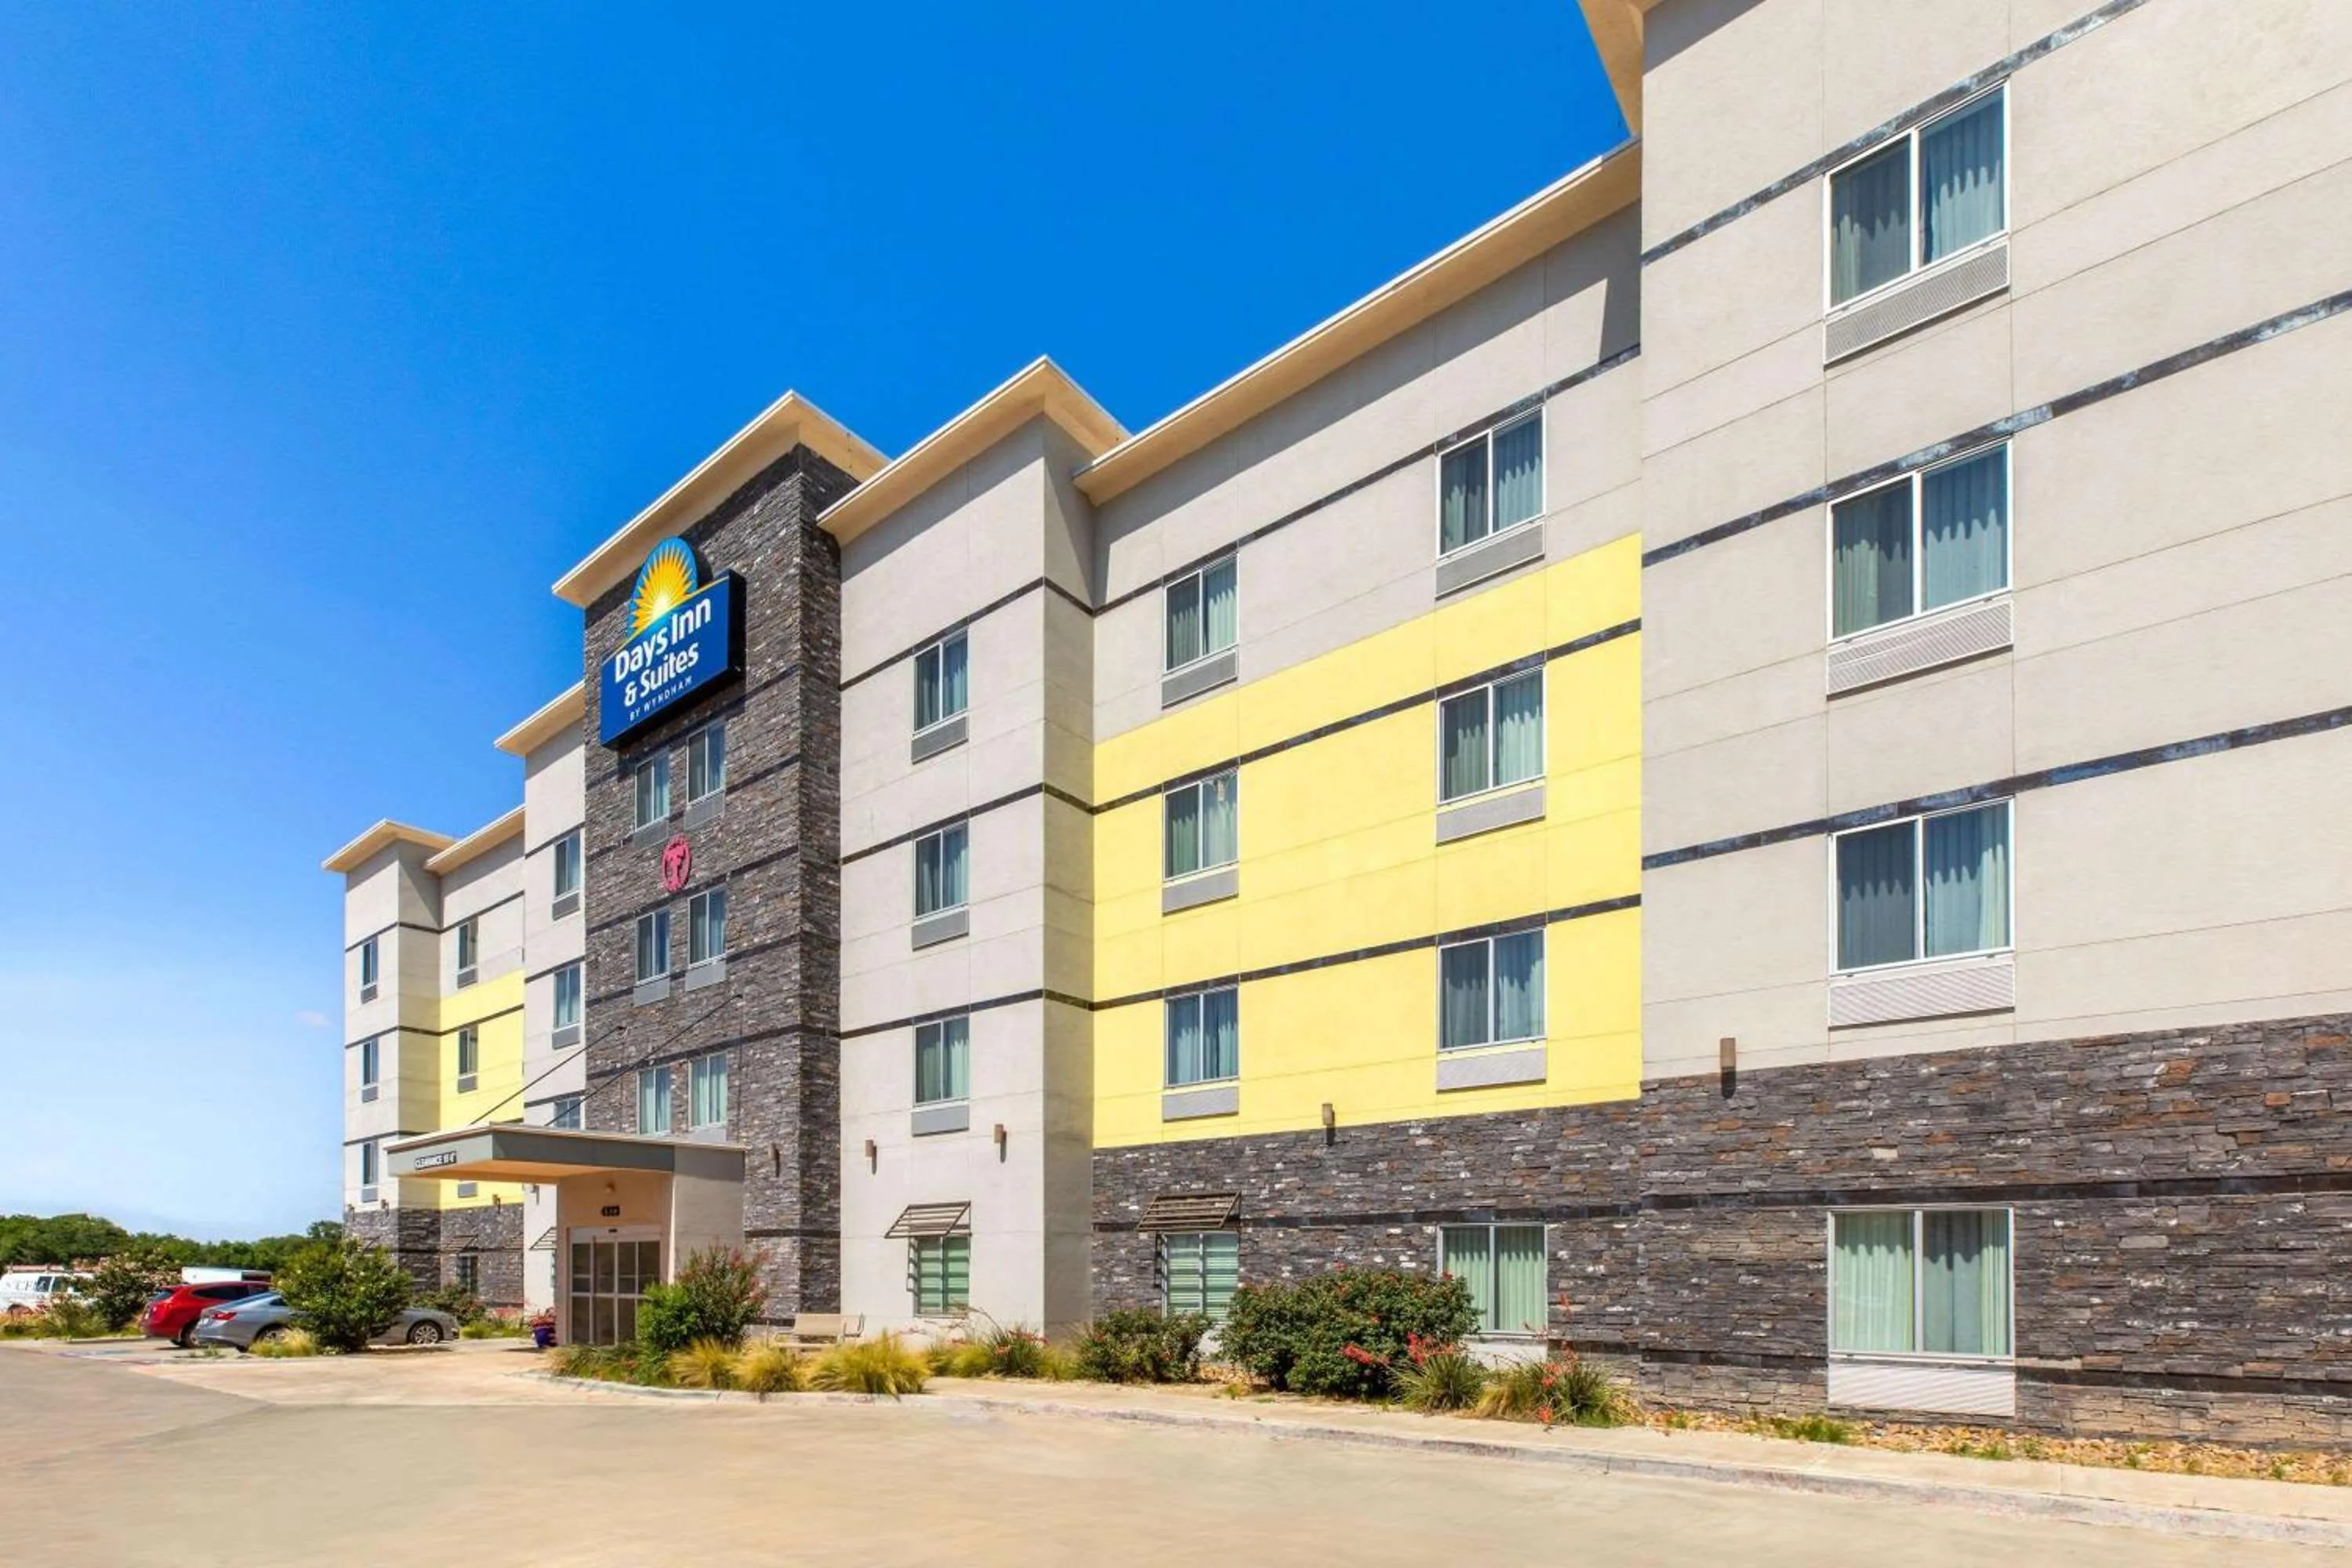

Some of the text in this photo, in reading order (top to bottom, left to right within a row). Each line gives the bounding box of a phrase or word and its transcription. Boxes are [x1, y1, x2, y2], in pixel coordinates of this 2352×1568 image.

[615, 598, 711, 684] Days Inn
[624, 642, 699, 706] & Suites
[630, 676, 692, 721] BY WYNDHAM
